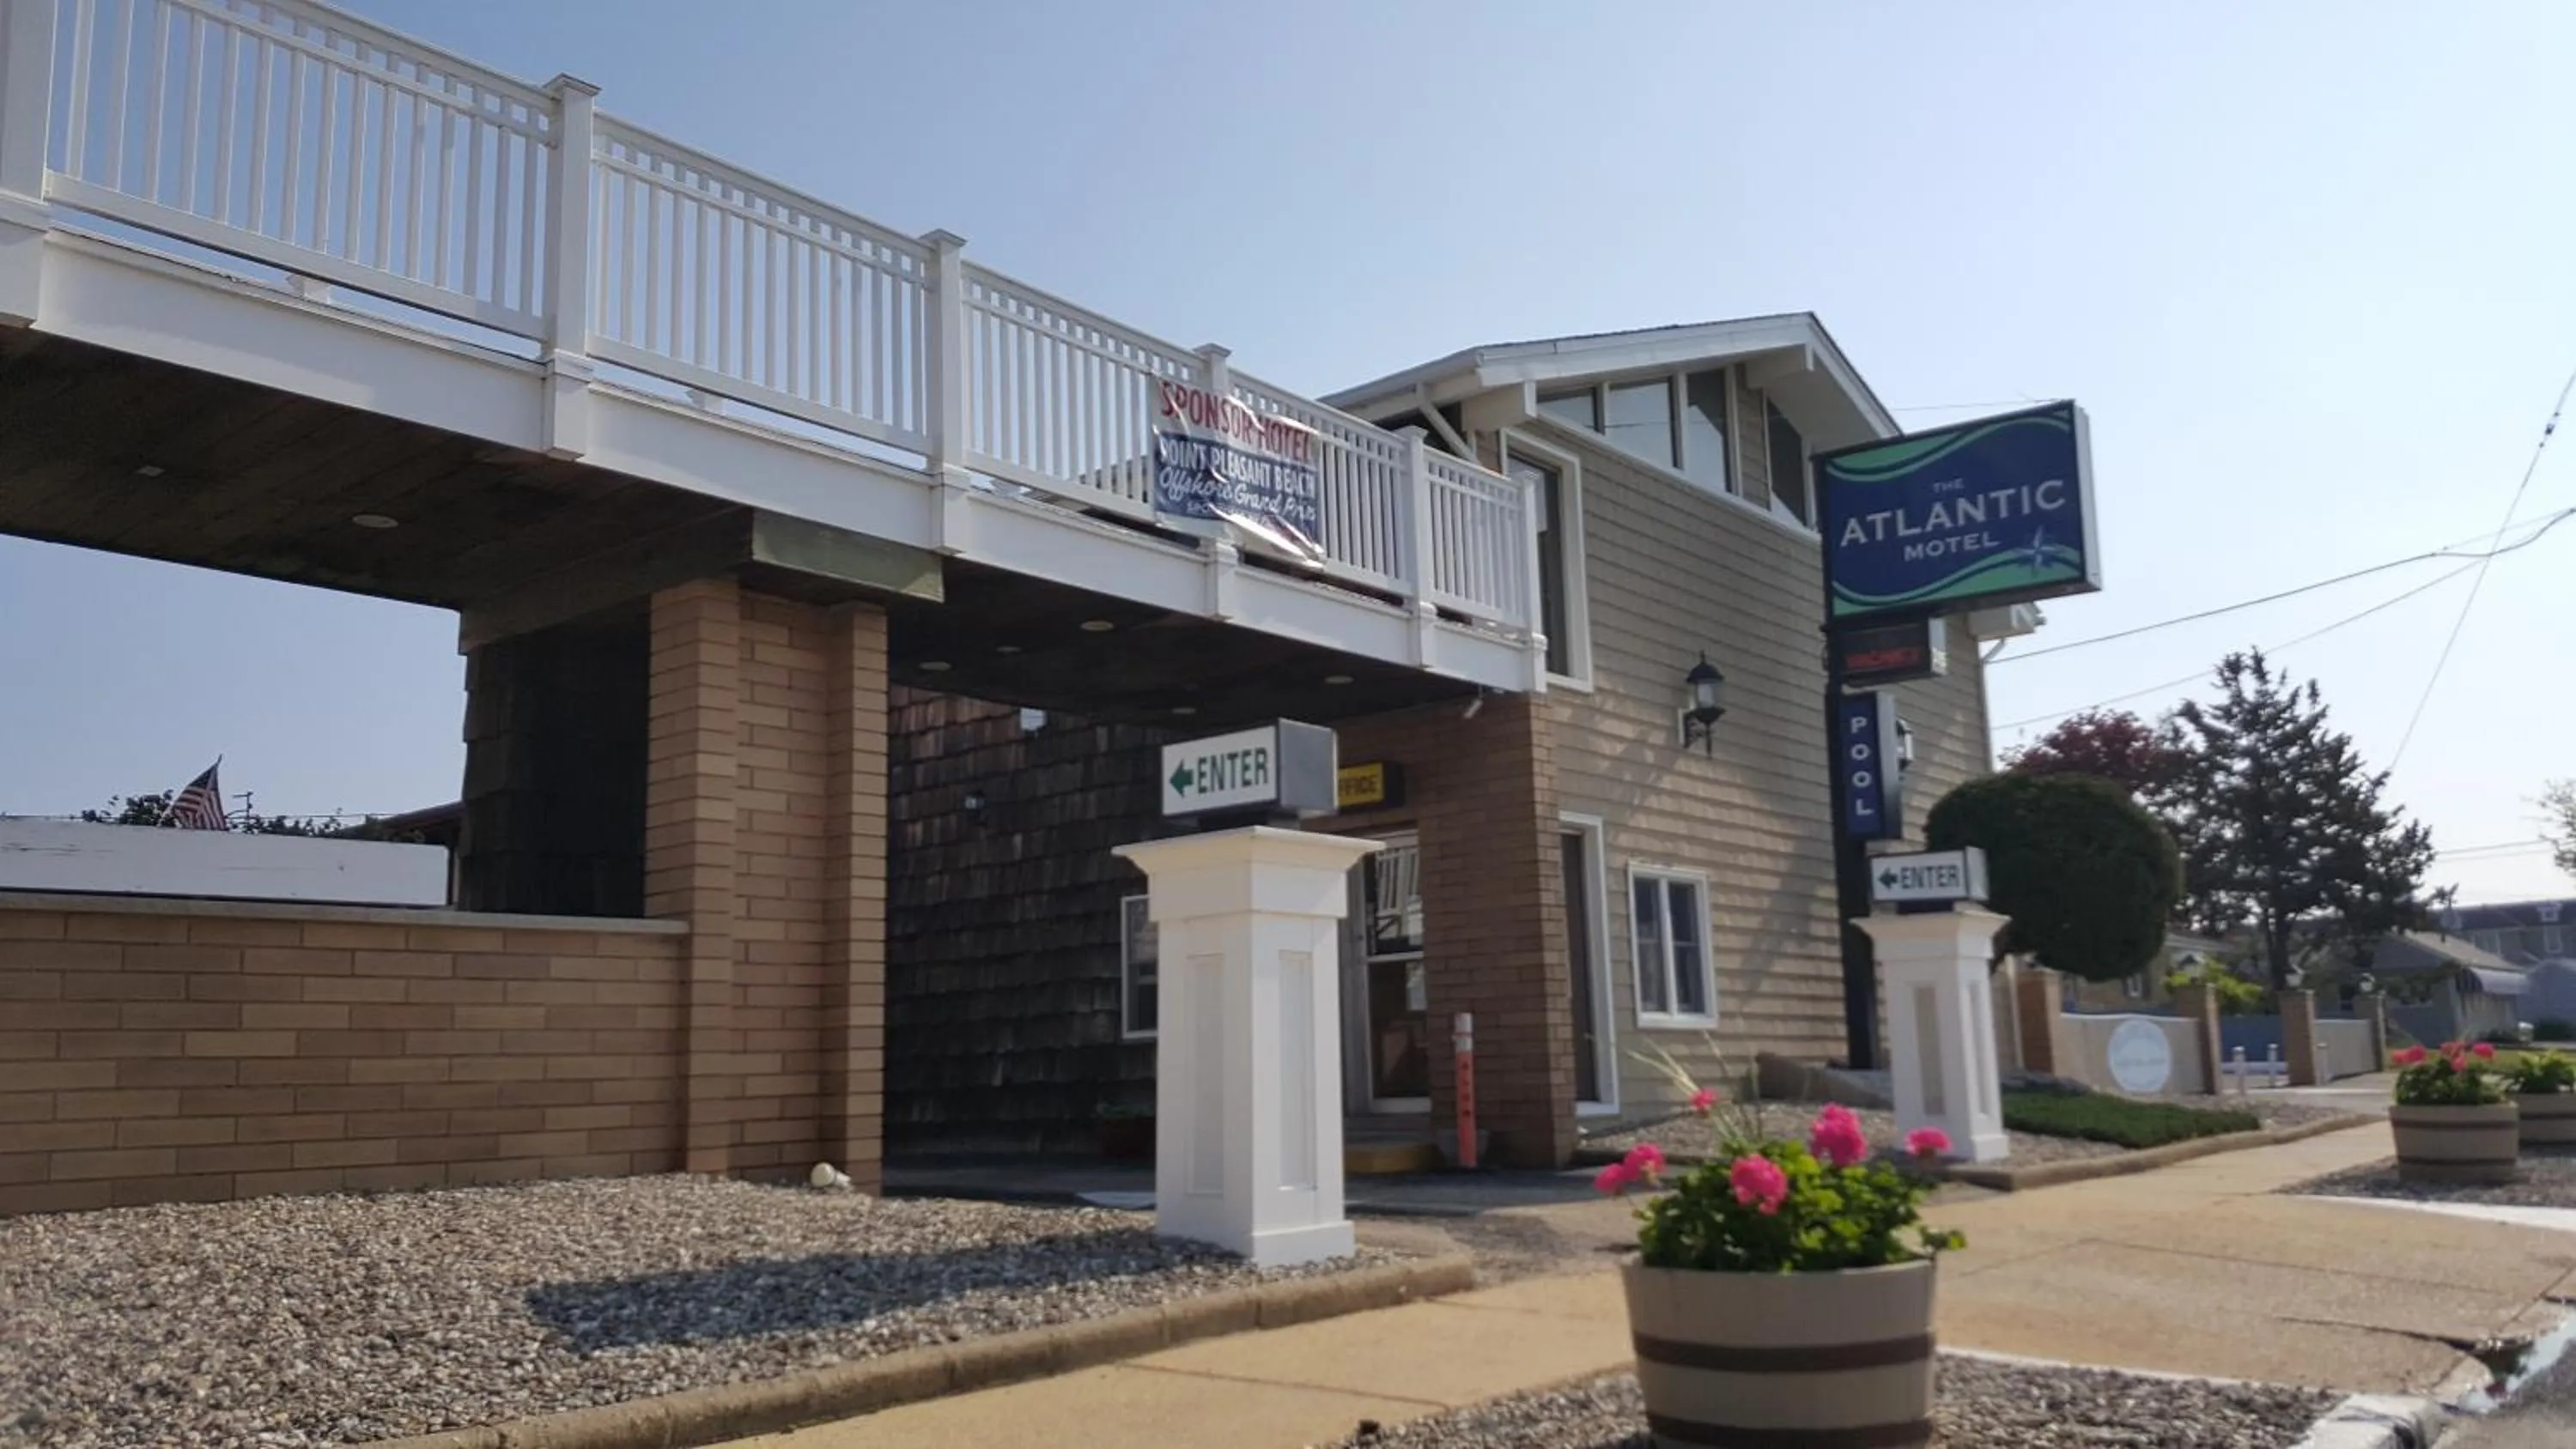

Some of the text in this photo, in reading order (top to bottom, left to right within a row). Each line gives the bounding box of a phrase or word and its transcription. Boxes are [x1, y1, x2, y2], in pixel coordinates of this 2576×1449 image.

[1161, 380, 1312, 462] SPONSOR HOTEL
[1210, 446, 1272, 489] PLEASANT
[1274, 464, 1316, 498] BEACH
[1933, 478, 1965, 494] THE
[1234, 483, 1281, 514] Grand
[1840, 480, 2065, 547] ATLANTIC
[1904, 530, 2002, 561] MOTEL
[1198, 747, 1268, 794] ENTER
[1850, 716, 1874, 815] POOL
[1900, 864, 1959, 890] ENTER
